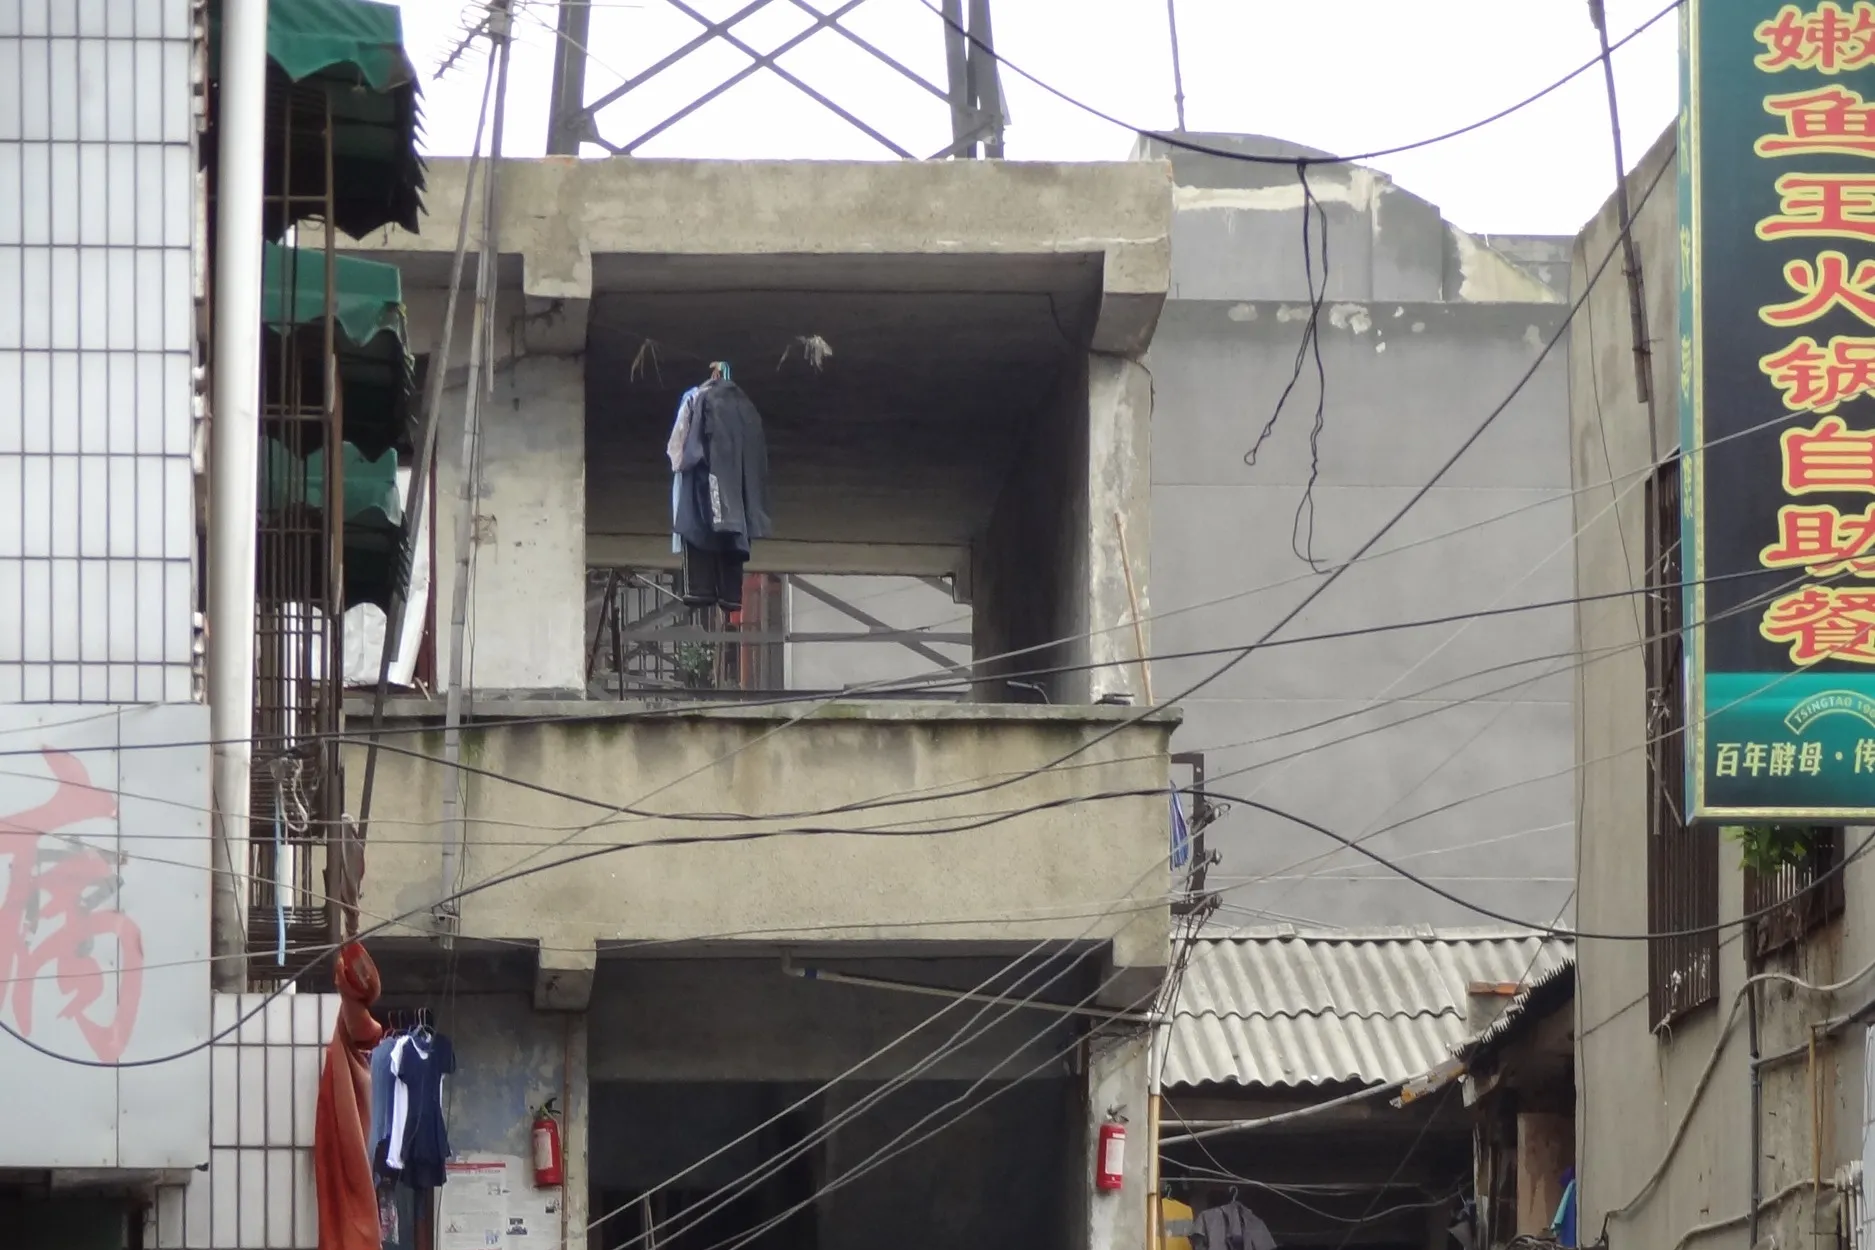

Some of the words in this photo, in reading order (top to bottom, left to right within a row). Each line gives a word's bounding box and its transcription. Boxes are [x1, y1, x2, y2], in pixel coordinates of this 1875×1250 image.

[1753, 3, 1875, 666] 嫩鱼王火锅自助餐
[1794, 696, 1852, 723] TSINGTAO
